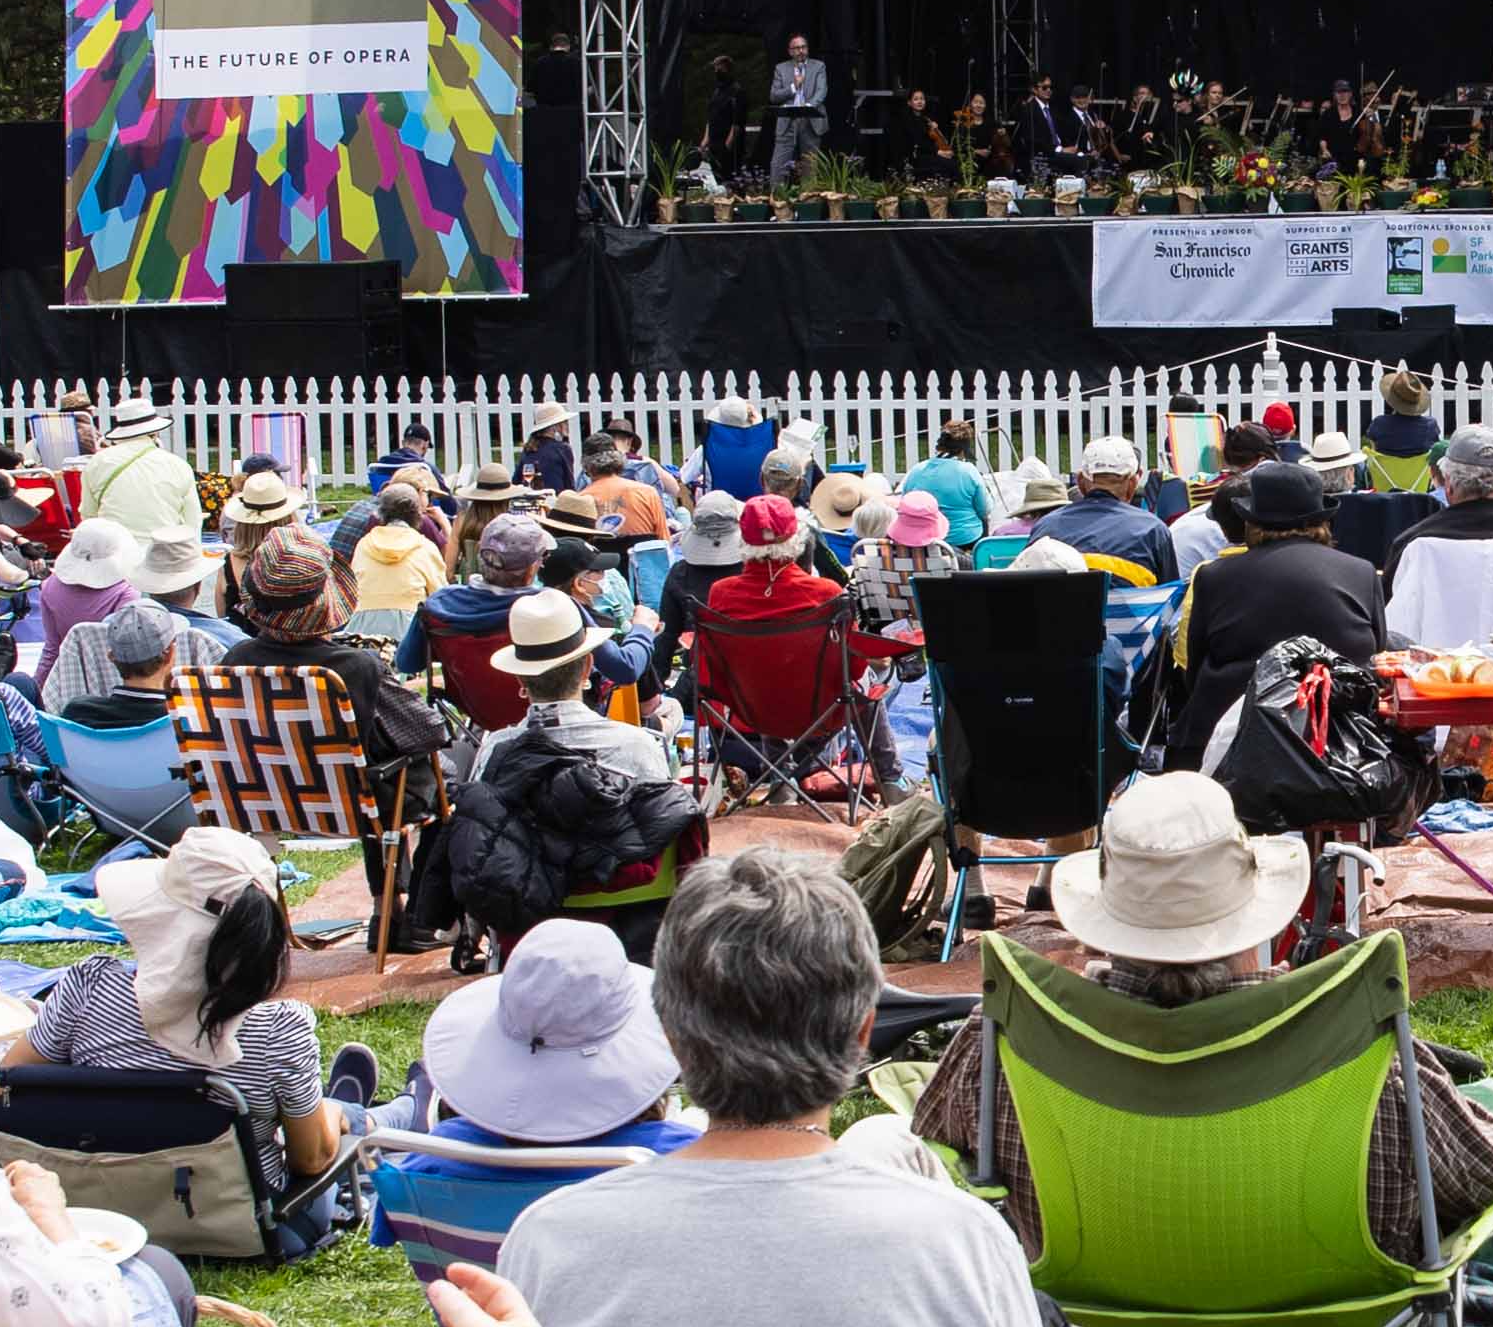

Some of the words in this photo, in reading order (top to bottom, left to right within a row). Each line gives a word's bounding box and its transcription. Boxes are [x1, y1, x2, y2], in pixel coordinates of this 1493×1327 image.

[169, 55, 209, 70] THE
[219, 52, 299, 68] FUTURE
[309, 50, 334, 65] OF
[343, 48, 411, 64] OPERA
[1211, 227, 1253, 235] SPONSOR
[1286, 226, 1337, 234] SUPPORTED
[1341, 225, 1352, 233] BY
[1386, 224, 1441, 232] ADDITIONAL
[1290, 241, 1349, 255] GRANTS
[1470, 236, 1483, 248] SF
[1154, 241, 1183, 260] San
[1184, 240, 1251, 259] Francisco
[1170, 262, 1235, 281] Chronicle
[1311, 259, 1349, 272] ARTS
